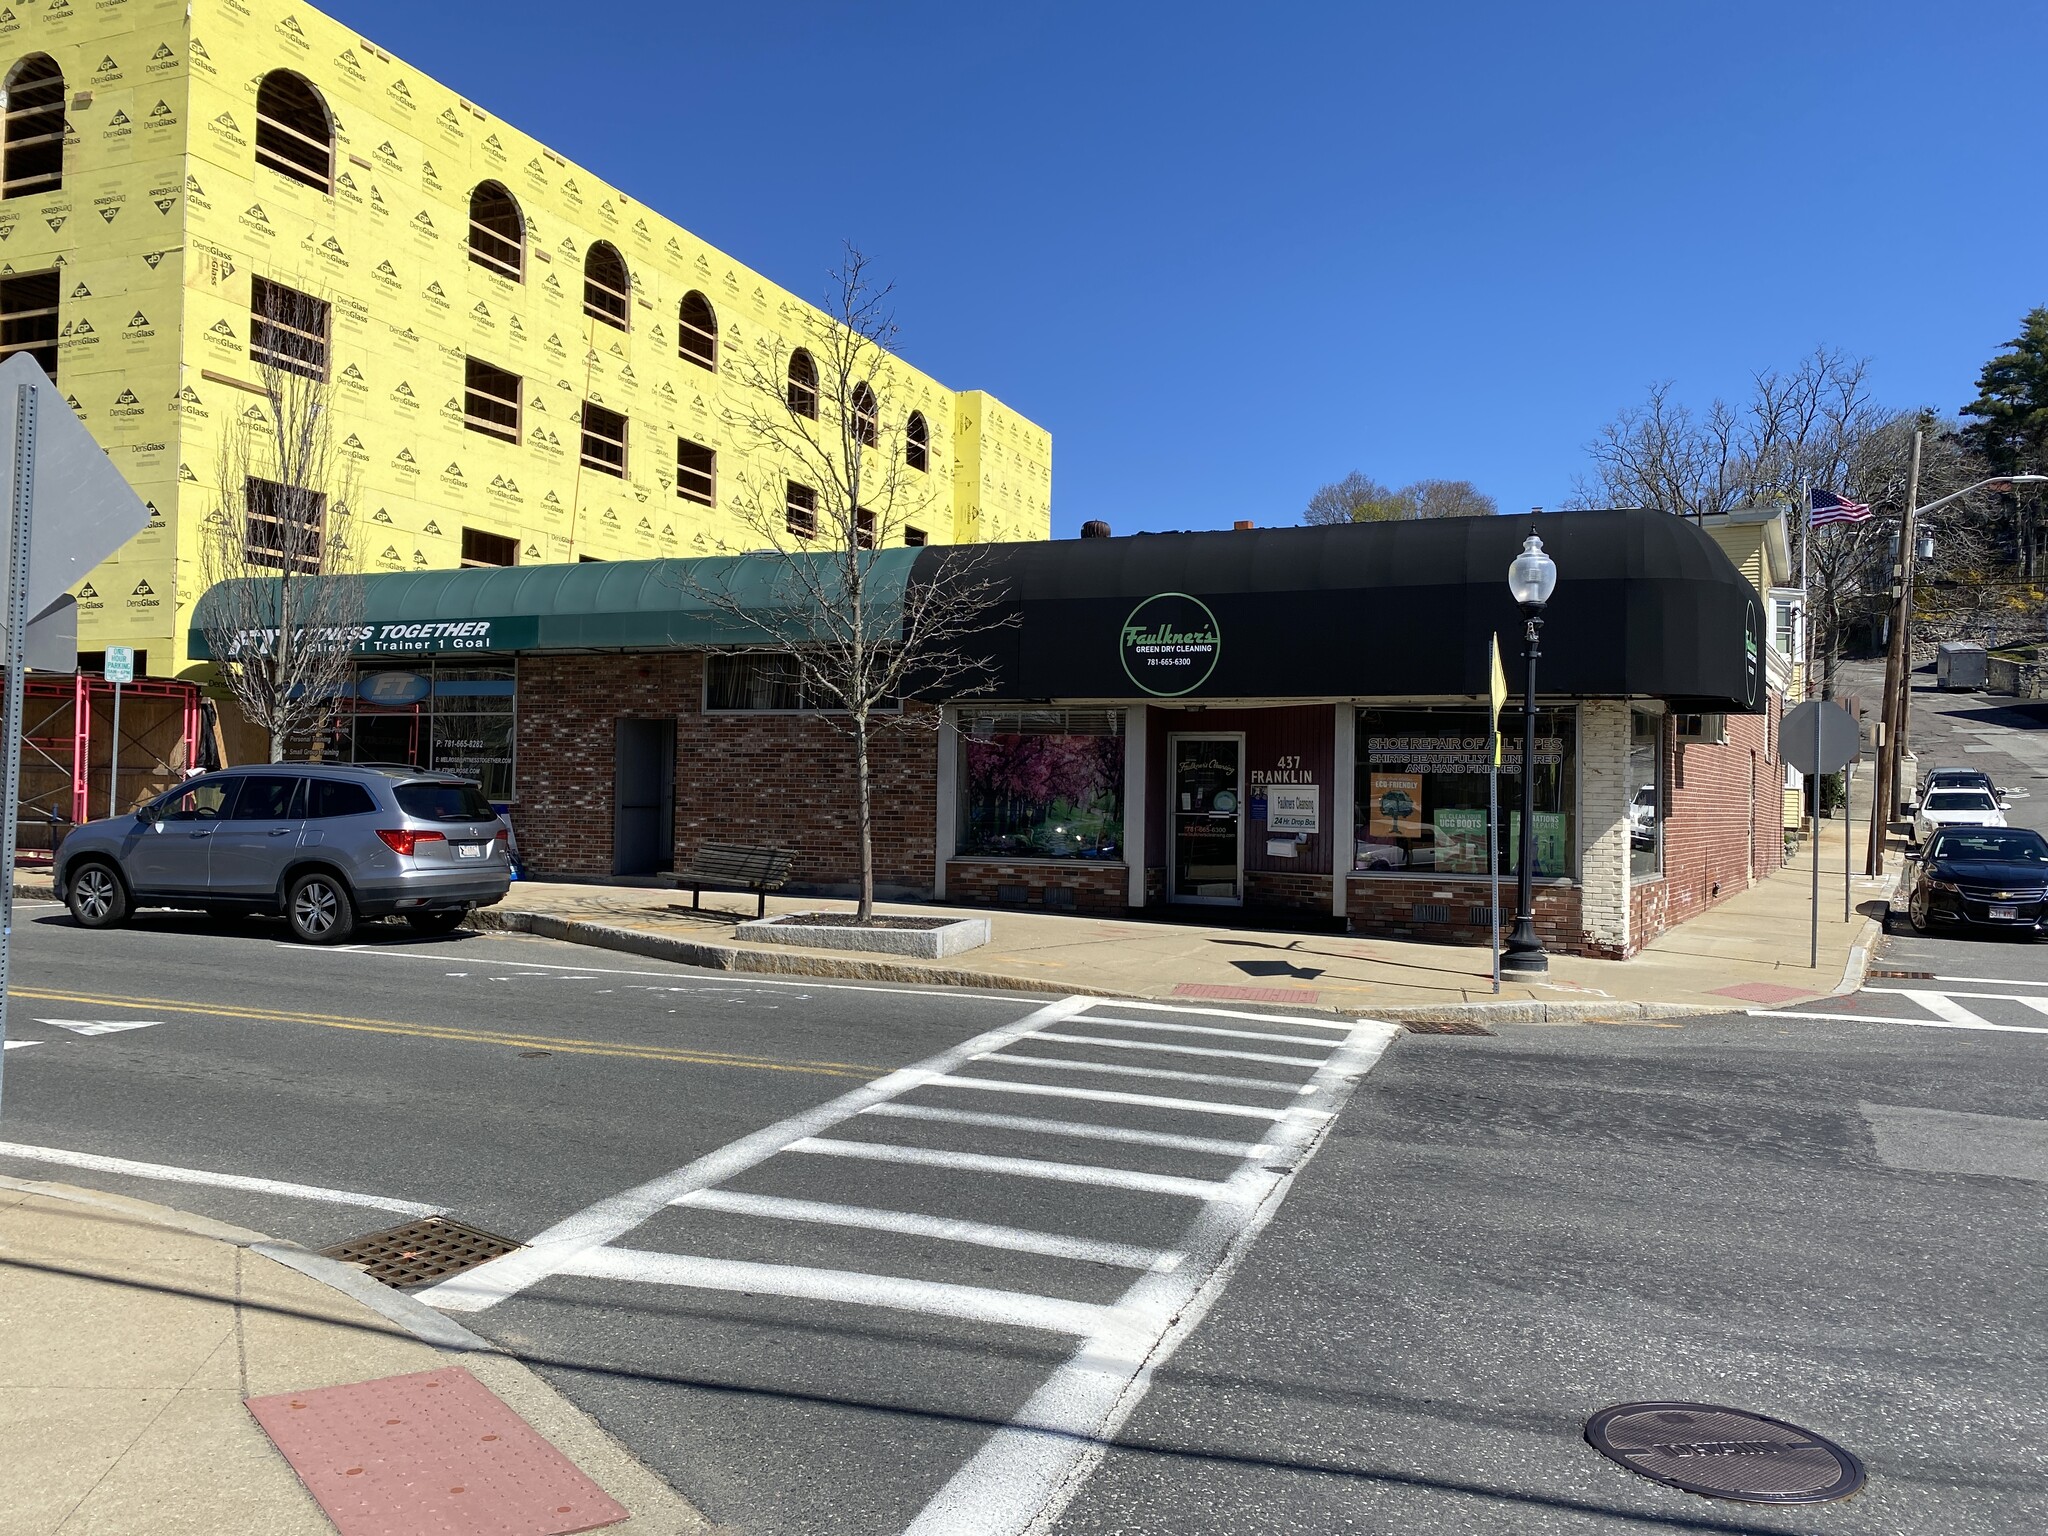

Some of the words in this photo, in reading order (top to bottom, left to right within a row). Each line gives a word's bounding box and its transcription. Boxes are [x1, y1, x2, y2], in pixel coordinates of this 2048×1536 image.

[42, 10, 73, 22] DensGlass
[275, 24, 310, 50] DensGlass
[146, 60, 179, 73] DensGlass
[334, 59, 366, 82] DensGlass
[91, 72, 123, 85] DensGlass
[386, 88, 416, 110] DensGlass
[144, 118, 177, 129] DensGlass
[436, 117, 464, 138] DensGlass
[208, 123, 247, 147] DensGlass
[481, 143, 507, 162] DensGlass
[372, 151, 402, 172] DensGlass
[239, 216, 276, 237] DensGlass
[410, 221, 439, 240] DensGlass
[192, 239, 233, 260] DensGlass
[316, 249, 350, 267] DensGlass
[372, 272, 402, 290] DensGlass
[489, 275, 514, 292] DensGlass
[422, 292, 450, 309] DensGlass
[335, 306, 368, 323] DensGlass
[469, 312, 495, 328] DensGlass
[122, 330, 155, 339] DensGlass
[203, 332, 244, 352] DensGlass
[389, 326, 420, 342] DensGlass
[337, 376, 369, 392] DensGlass
[390, 394, 420, 409] DensGlass
[132, 443, 165, 453] DensGlass
[338, 447, 370, 461] DensGlass
[391, 461, 421, 475] DensGlass
[440, 475, 468, 488] DensGlass
[540, 502, 563, 514] DensGlass
[127, 598, 159, 607] DensGlass
[380, 622, 490, 639] TOGETHER
[1124, 624, 1219, 646] Faulkner's
[360, 642, 365, 650] 1
[374, 641, 430, 650] Trainer
[438, 640, 443, 648] 1
[453, 638, 490, 648] Goal
[1147, 658, 1190, 666] 781-665-6300
[373, 677, 416, 695] FT
[1368, 738, 1408, 750] SHOE
[1410, 738, 1460, 750] REPAIR
[1462, 738, 1484, 750] OF
[1513, 738, 1562, 750] TPES
[1278, 756, 1300, 768] 437
[1369, 754, 1410, 764] SHIRTS
[1411, 754, 1487, 764] BEAUTIFULLY
[1251, 770, 1312, 783] FRANKLIN
[1405, 764, 1431, 773] AND
[1432, 764, 1465, 773] HAND
[1467, 765, 1521, 774] FINIHED
[1376, 781, 1418, 789] ECO-FRIENDLY
[1457, 820, 1481, 828] BOOTS
